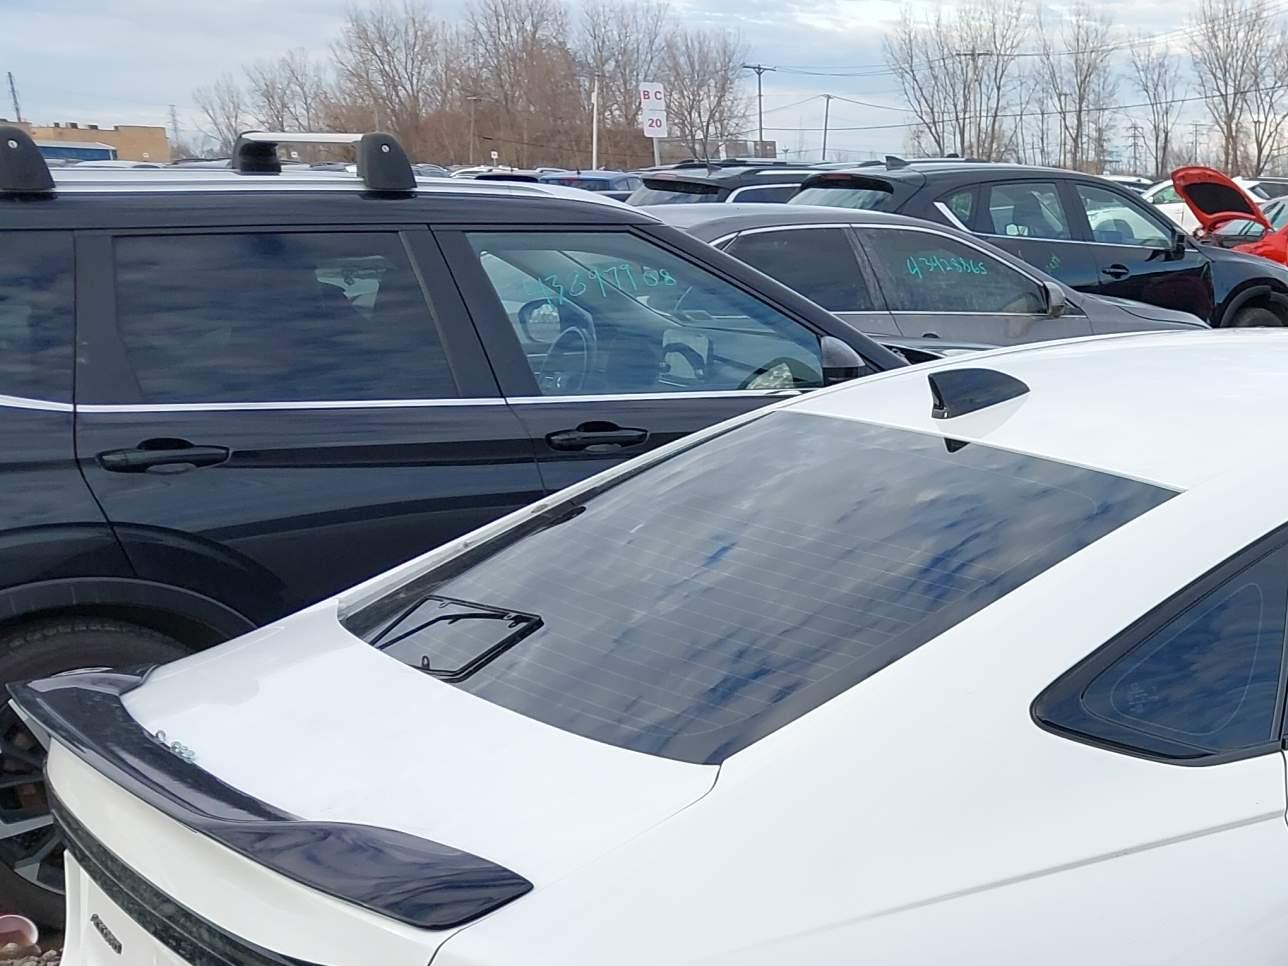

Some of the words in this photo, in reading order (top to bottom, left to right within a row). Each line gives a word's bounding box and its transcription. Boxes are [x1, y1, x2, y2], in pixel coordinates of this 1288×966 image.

[642, 90, 651, 100] B
[654, 90, 663, 101] C
[647, 118, 662, 128] 20
